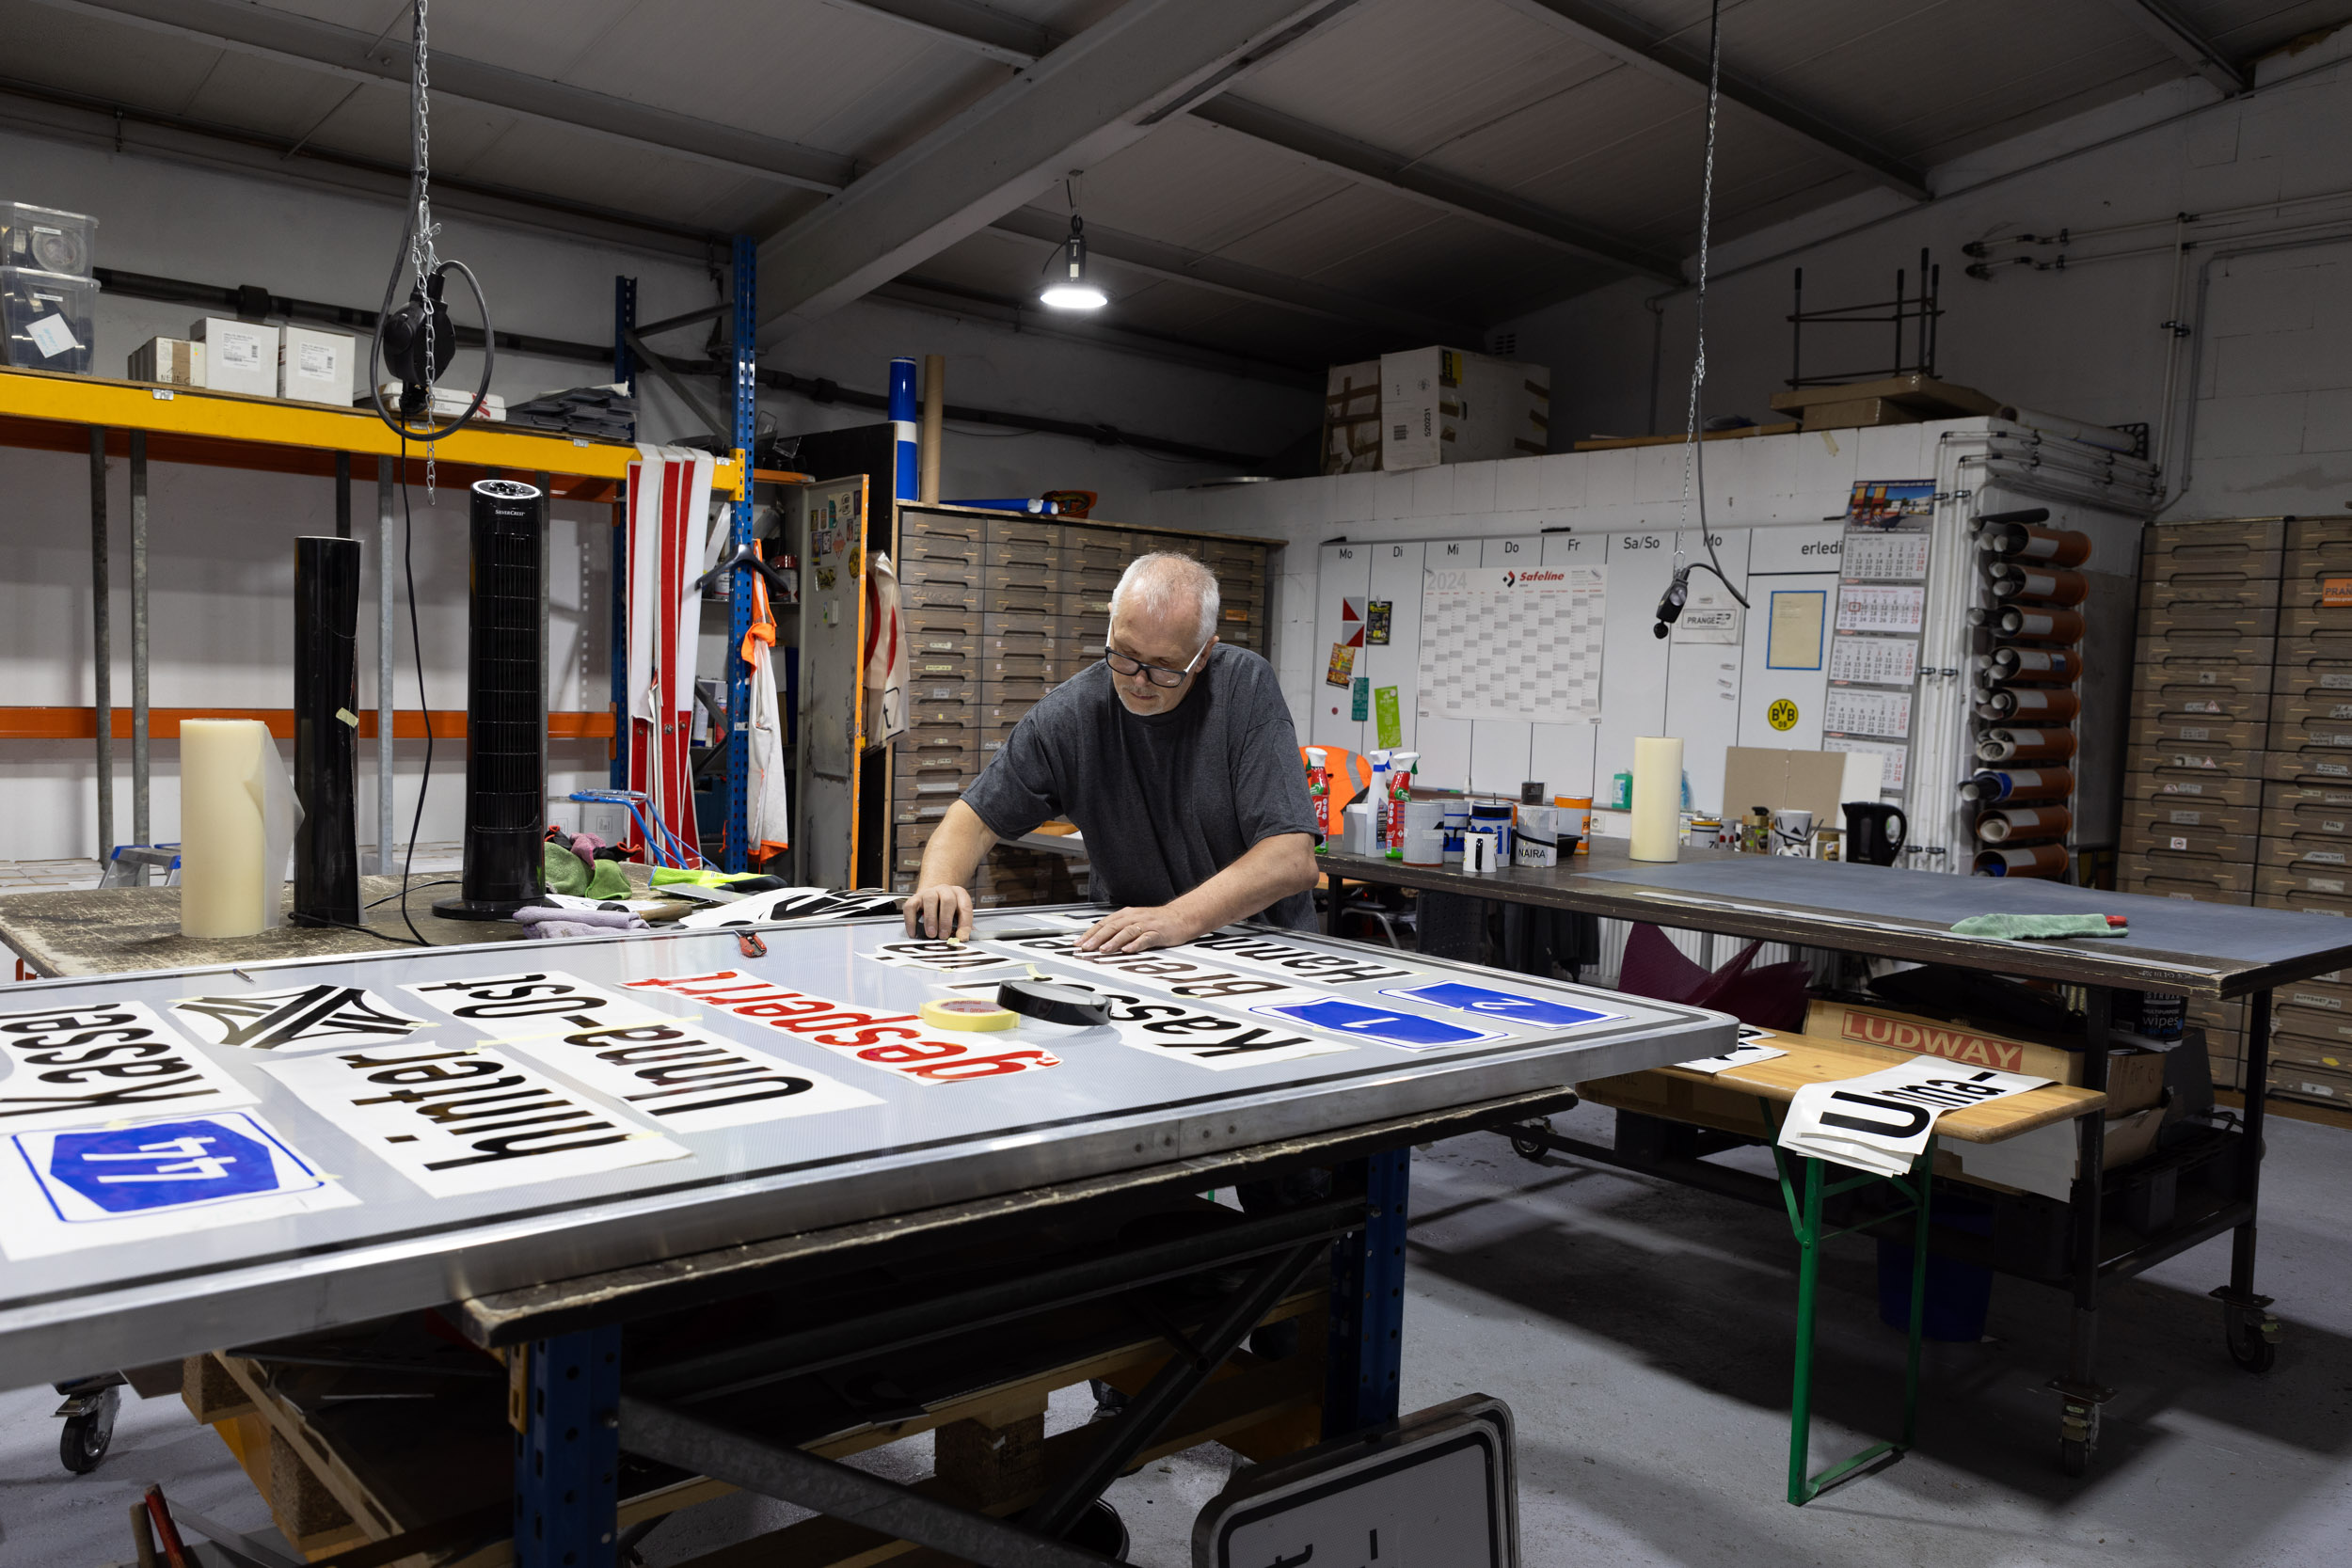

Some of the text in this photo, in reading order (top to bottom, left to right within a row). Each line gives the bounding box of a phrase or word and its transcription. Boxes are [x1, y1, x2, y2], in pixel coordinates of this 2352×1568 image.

[1423, 407, 1432, 437] 520231
[1504, 542, 1519, 553] Do
[1567, 540, 1581, 552] Fr
[1623, 536, 1661, 549] Sa/So
[1339, 548, 1353, 560] Mo
[1392, 546, 1404, 558] Di
[1447, 544, 1459, 556] Mi
[1425, 572, 1468, 591] 2024
[1518, 571, 1565, 582] Safeline
[1687, 616, 1716, 625] PRANGE
[1771, 702, 1795, 721] BVB
[1518, 848, 1546, 858] NAIRA
[1471, 998, 1535, 1011] 2
[946, 977, 1314, 1058] Kassl
[1341, 1017, 1401, 1029] 1
[2142, 1015, 2179, 1029] wipes
[623, 971, 1060, 1080] gesperrt
[1843, 1011, 2023, 1069] LUDWAY
[1819, 1070, 2005, 1139] Unna-
[336, 1051, 632, 1172] hinter
[82, 1136, 237, 1184] 44
